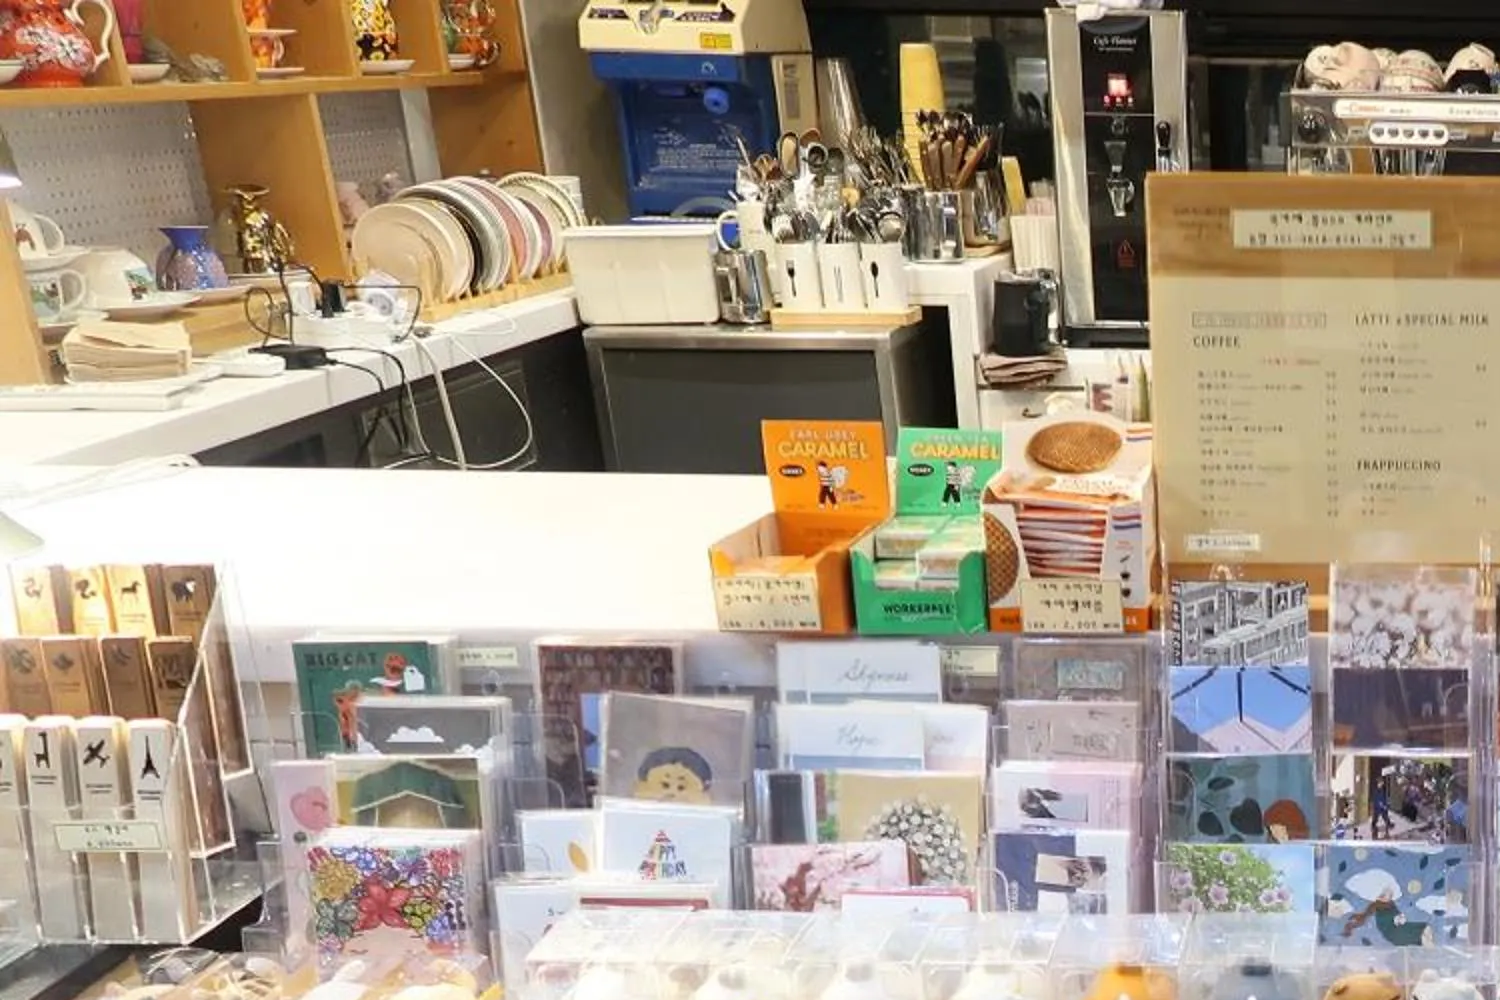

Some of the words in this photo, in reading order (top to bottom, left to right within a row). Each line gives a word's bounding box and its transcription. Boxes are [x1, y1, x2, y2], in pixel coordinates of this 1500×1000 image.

[1404, 315, 1453, 326] SPECIAL
[1459, 315, 1489, 326] MILK
[1193, 336, 1240, 348] COFFEE
[778, 441, 868, 459] CARAMEL
[911, 443, 1000, 461] CARAMEL
[1356, 460, 1441, 471] FRAPPUCCINO
[304, 653, 339, 667] BIG
[344, 652, 378, 667] CAT
